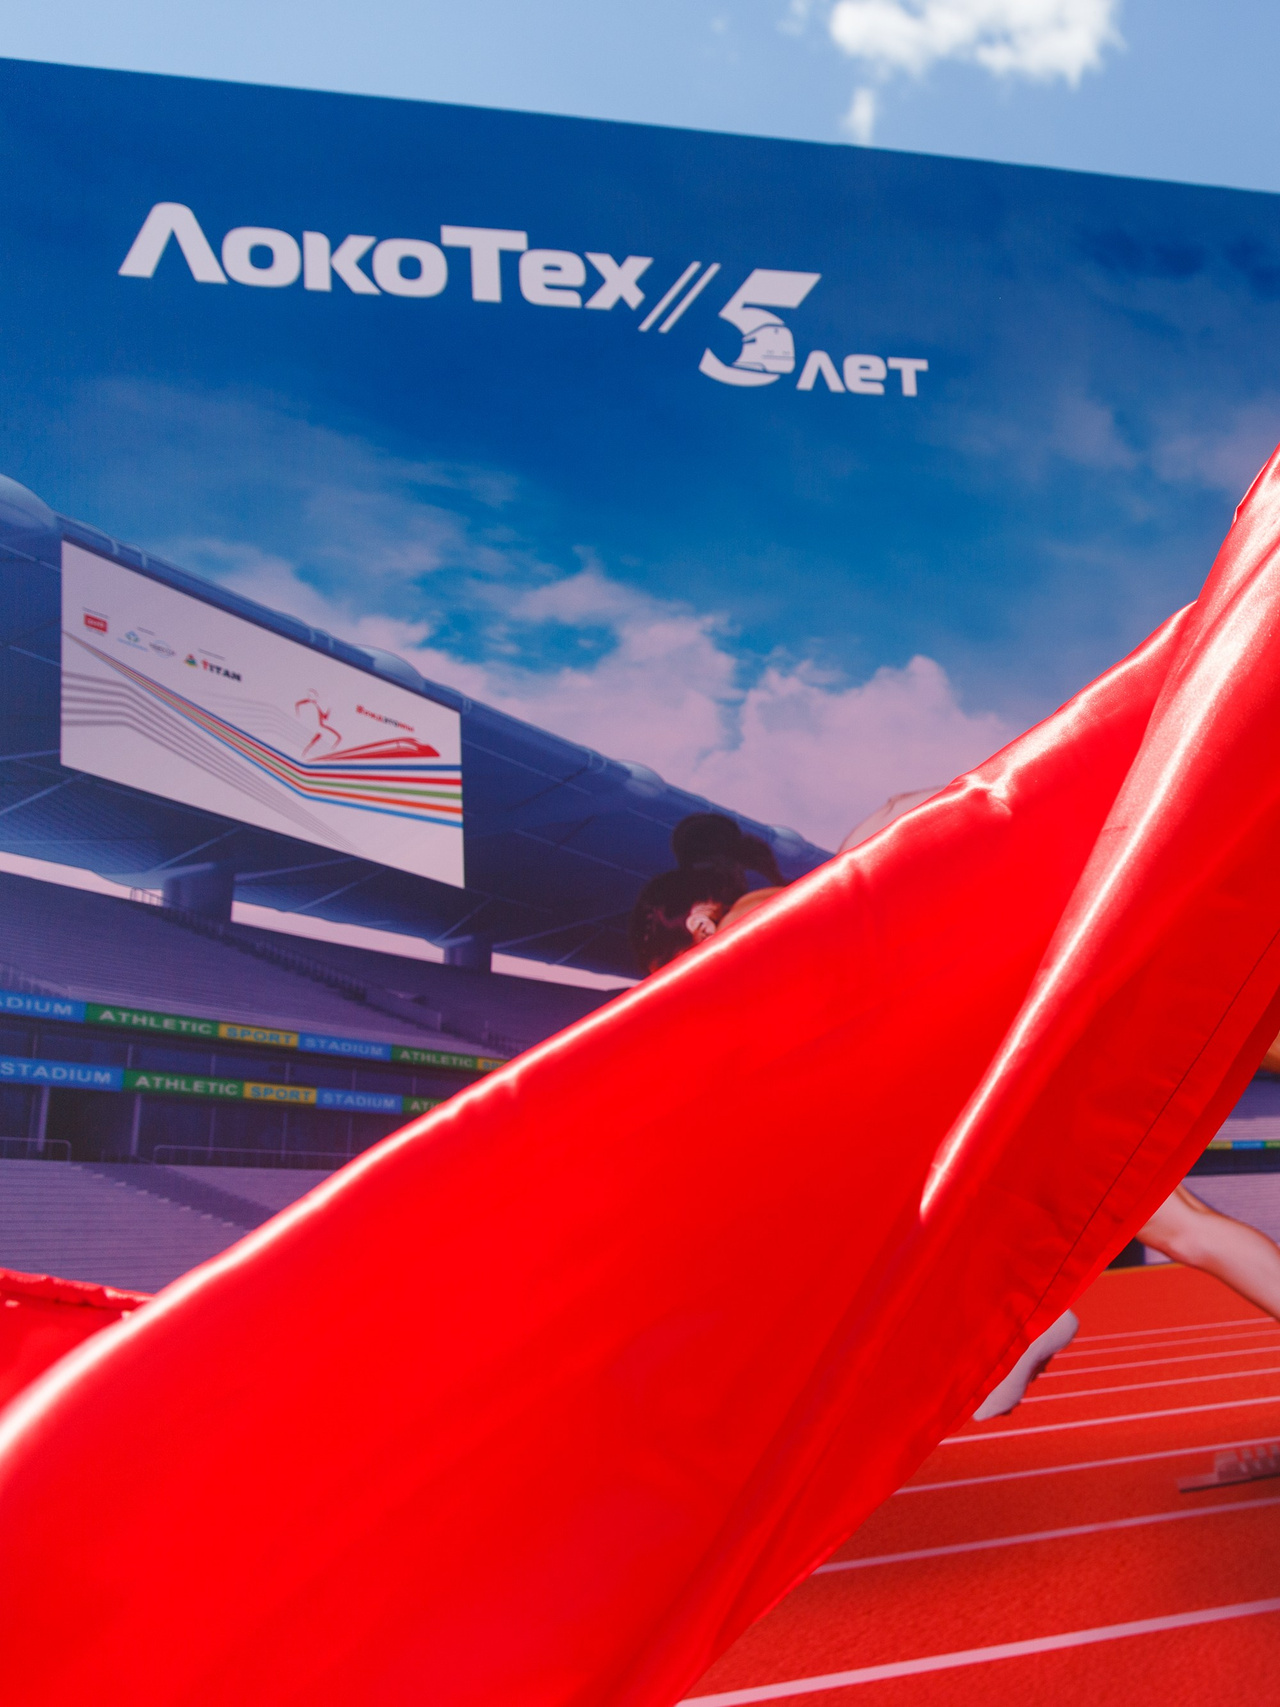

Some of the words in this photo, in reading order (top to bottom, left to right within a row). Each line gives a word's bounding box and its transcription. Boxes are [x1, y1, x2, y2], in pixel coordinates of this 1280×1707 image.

[0, 996, 72, 1016] DIUM
[99, 1009, 213, 1035] ATHLETIC
[226, 1027, 293, 1044] SPORT
[305, 1037, 384, 1056] STADIUM
[400, 1050, 473, 1068] ATHLETIC
[0, 1062, 111, 1084] STADIUM
[135, 1075, 239, 1096] ATHLETIC
[251, 1086, 312, 1102] SPORT
[322, 1092, 396, 1109] STADIUM
